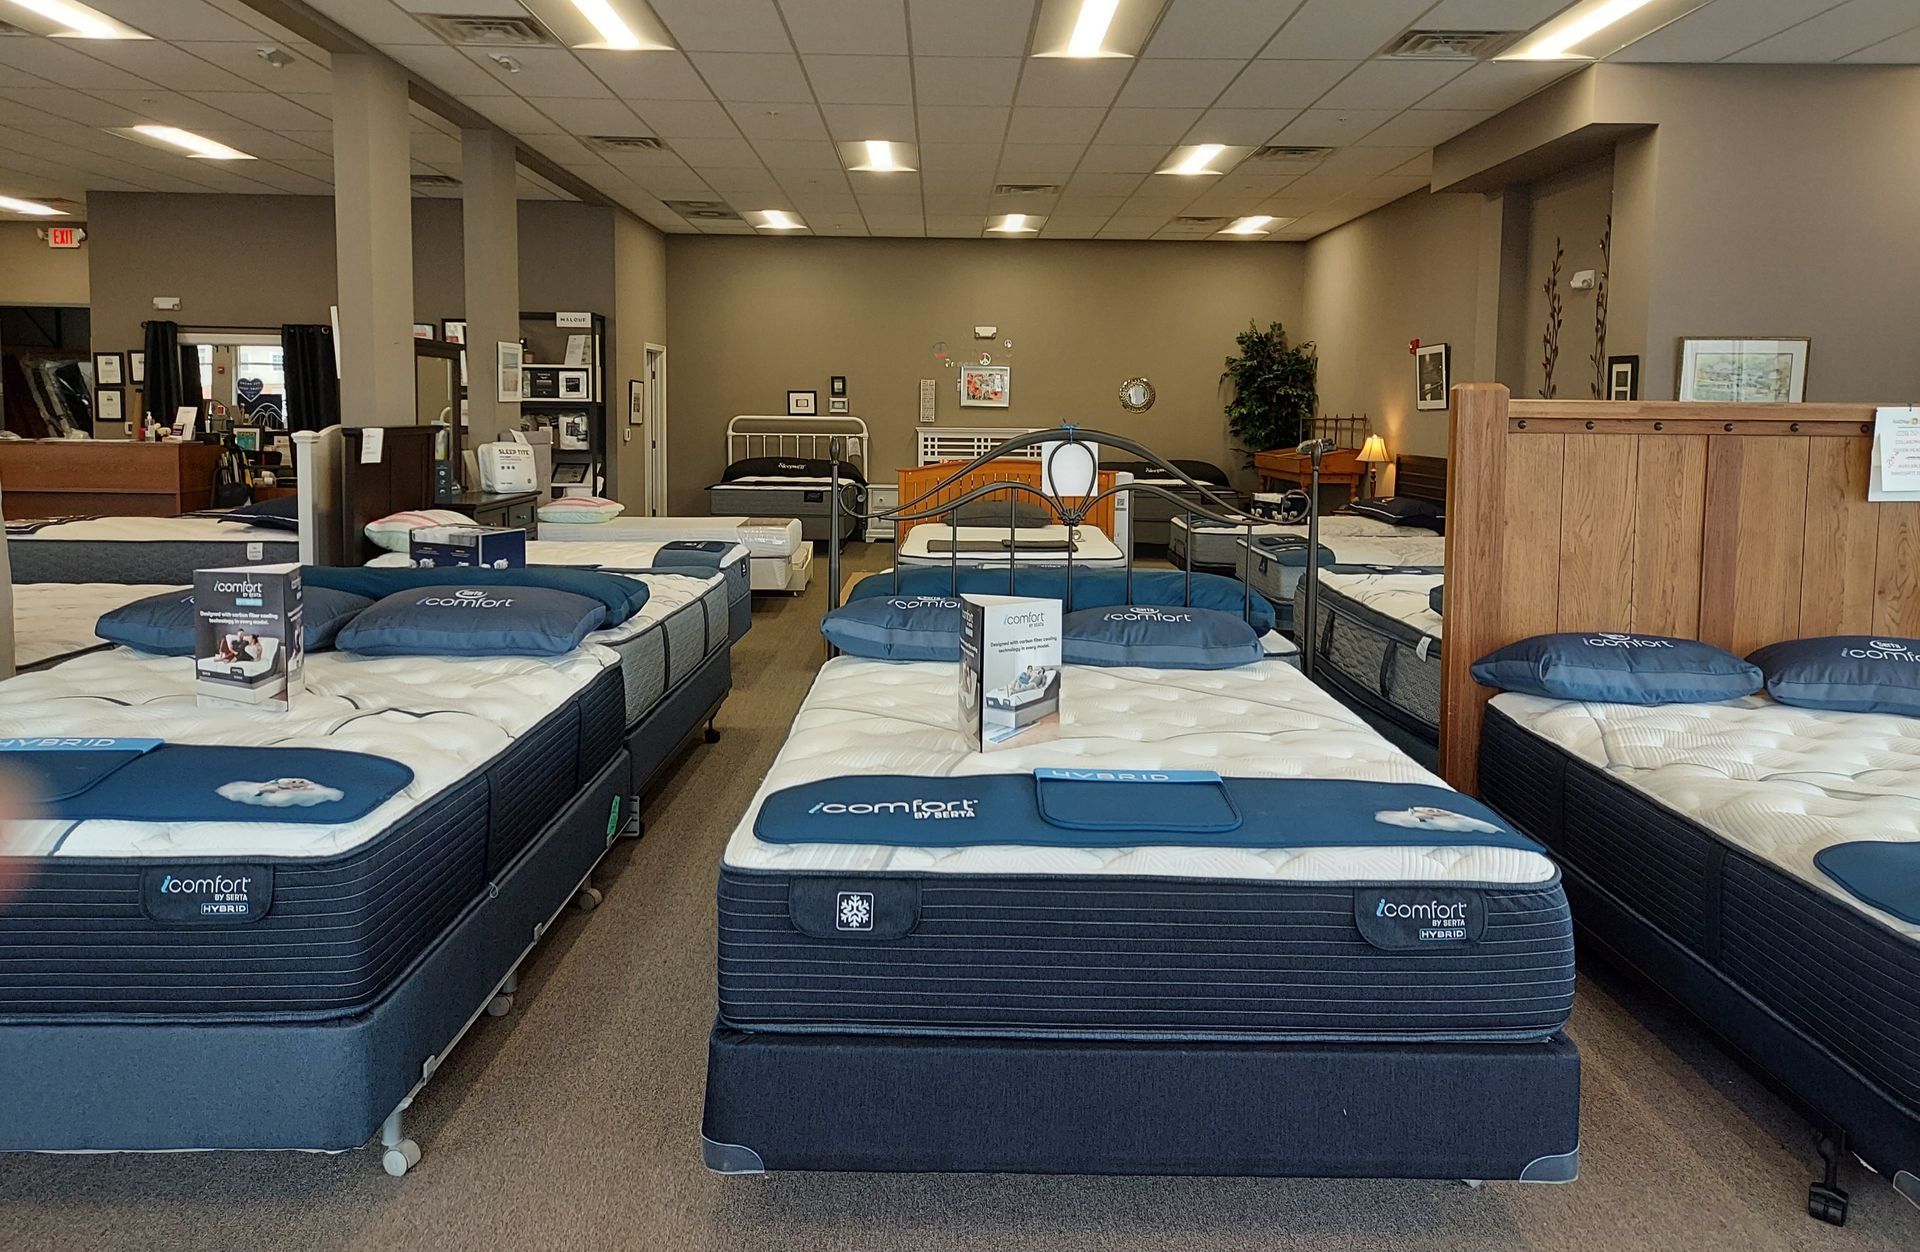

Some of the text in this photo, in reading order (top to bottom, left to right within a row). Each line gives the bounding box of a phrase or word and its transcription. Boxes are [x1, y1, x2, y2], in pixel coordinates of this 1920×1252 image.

[53, 229, 73, 245] EXIT
[213, 580, 263, 593] icomfort
[887, 598, 960, 609] icomfo
[1003, 611, 1044, 625] icomfort
[1052, 769, 1169, 781] HYBRID
[914, 810, 976, 820] BY SERTA
[160, 875, 251, 894] icomfort
[214, 893, 248, 902] BY SERTA
[203, 904, 247, 913] HYBRID
[1376, 898, 1467, 919] icomfort
[1432, 919, 1466, 928] BY SERTA
[1421, 930, 1464, 938] HYBRID
